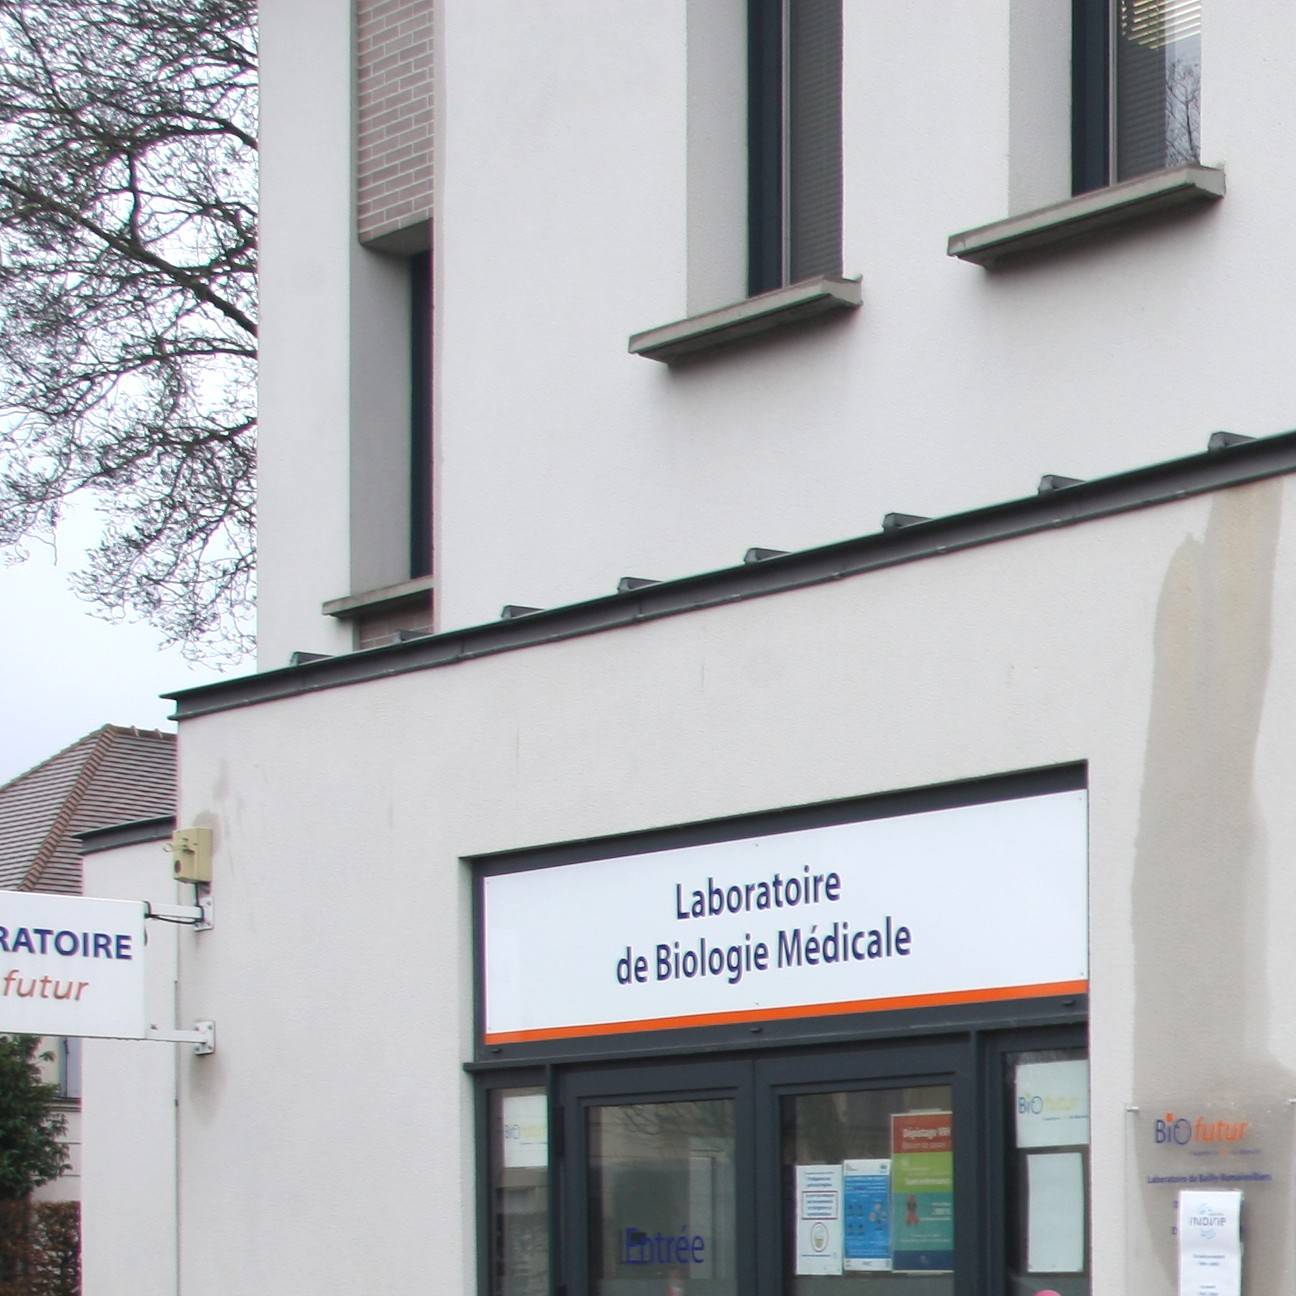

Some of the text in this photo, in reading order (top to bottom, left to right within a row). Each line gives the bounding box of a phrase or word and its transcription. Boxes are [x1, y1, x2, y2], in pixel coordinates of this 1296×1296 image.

[675, 864, 842, 920] Laboratoire
[616, 915, 912, 985] de Biologie Médicale
[3, 968, 90, 1002] futur
[625, 1223, 705, 1265] Entrée
